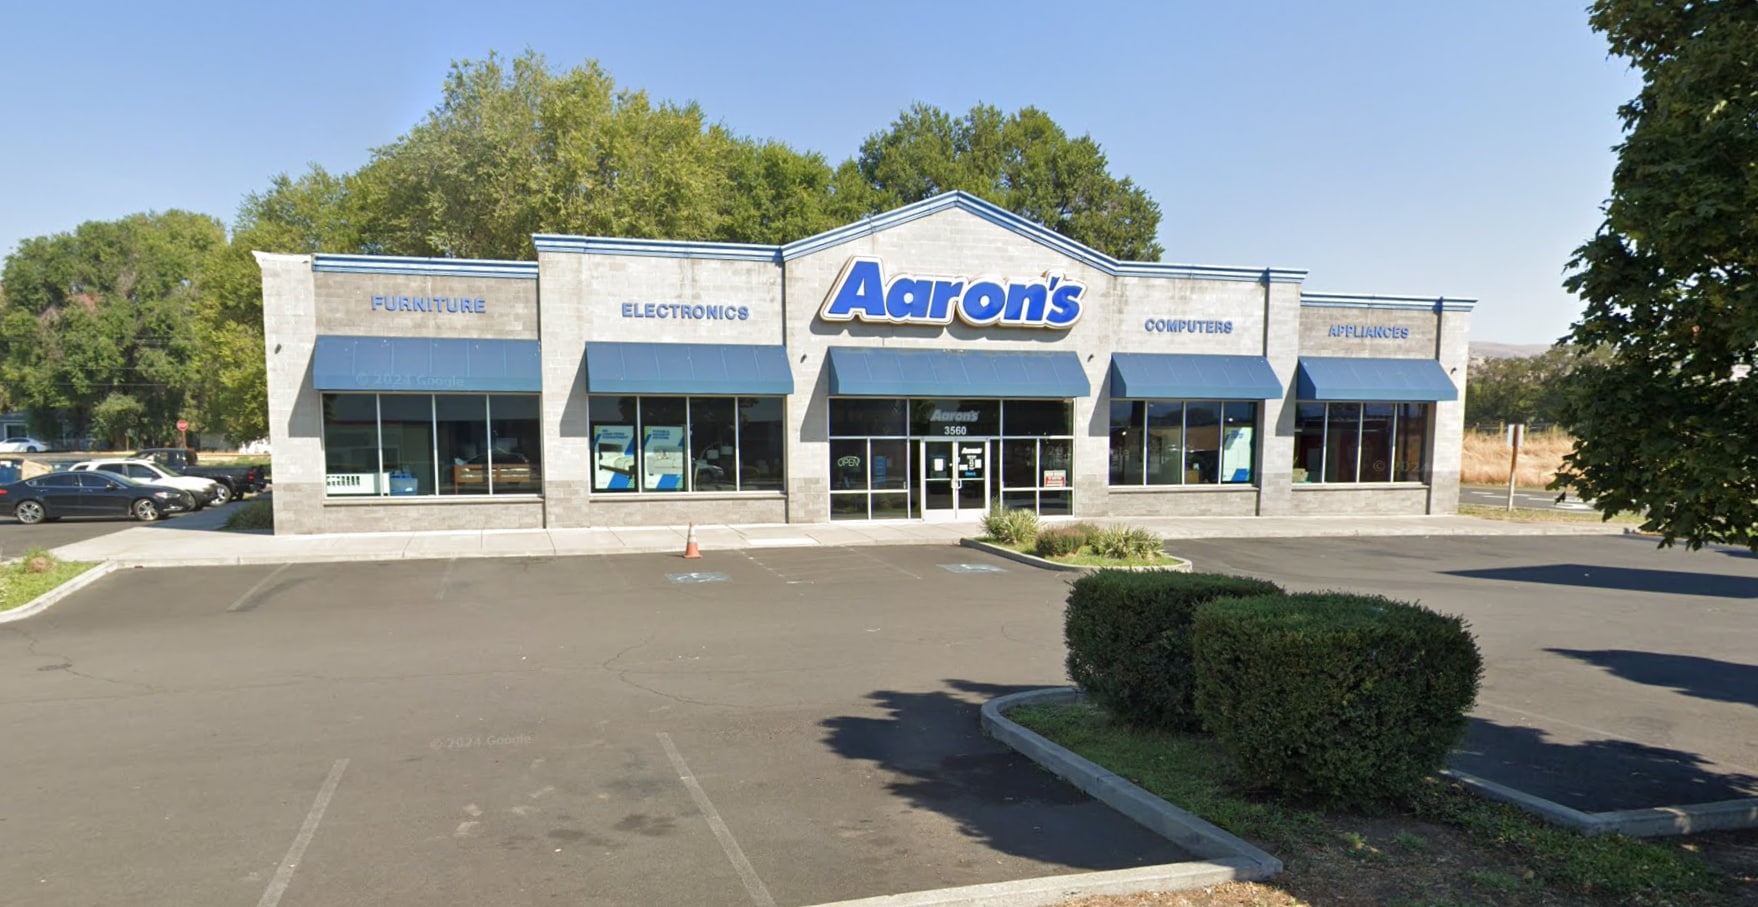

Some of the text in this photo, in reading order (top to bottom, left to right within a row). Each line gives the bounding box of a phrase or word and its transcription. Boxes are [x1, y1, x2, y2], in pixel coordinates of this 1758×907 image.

[825, 258, 1085, 327] Aaron's
[371, 295, 486, 314] FURNITURE
[621, 302, 750, 321] ELECTRONICS
[1144, 319, 1233, 334] COMPUTERS
[1328, 324, 1409, 339] APPLIANCES
[930, 409, 980, 422] Aaron's
[944, 425, 967, 435] 3560
[837, 455, 861, 468] OPEN
